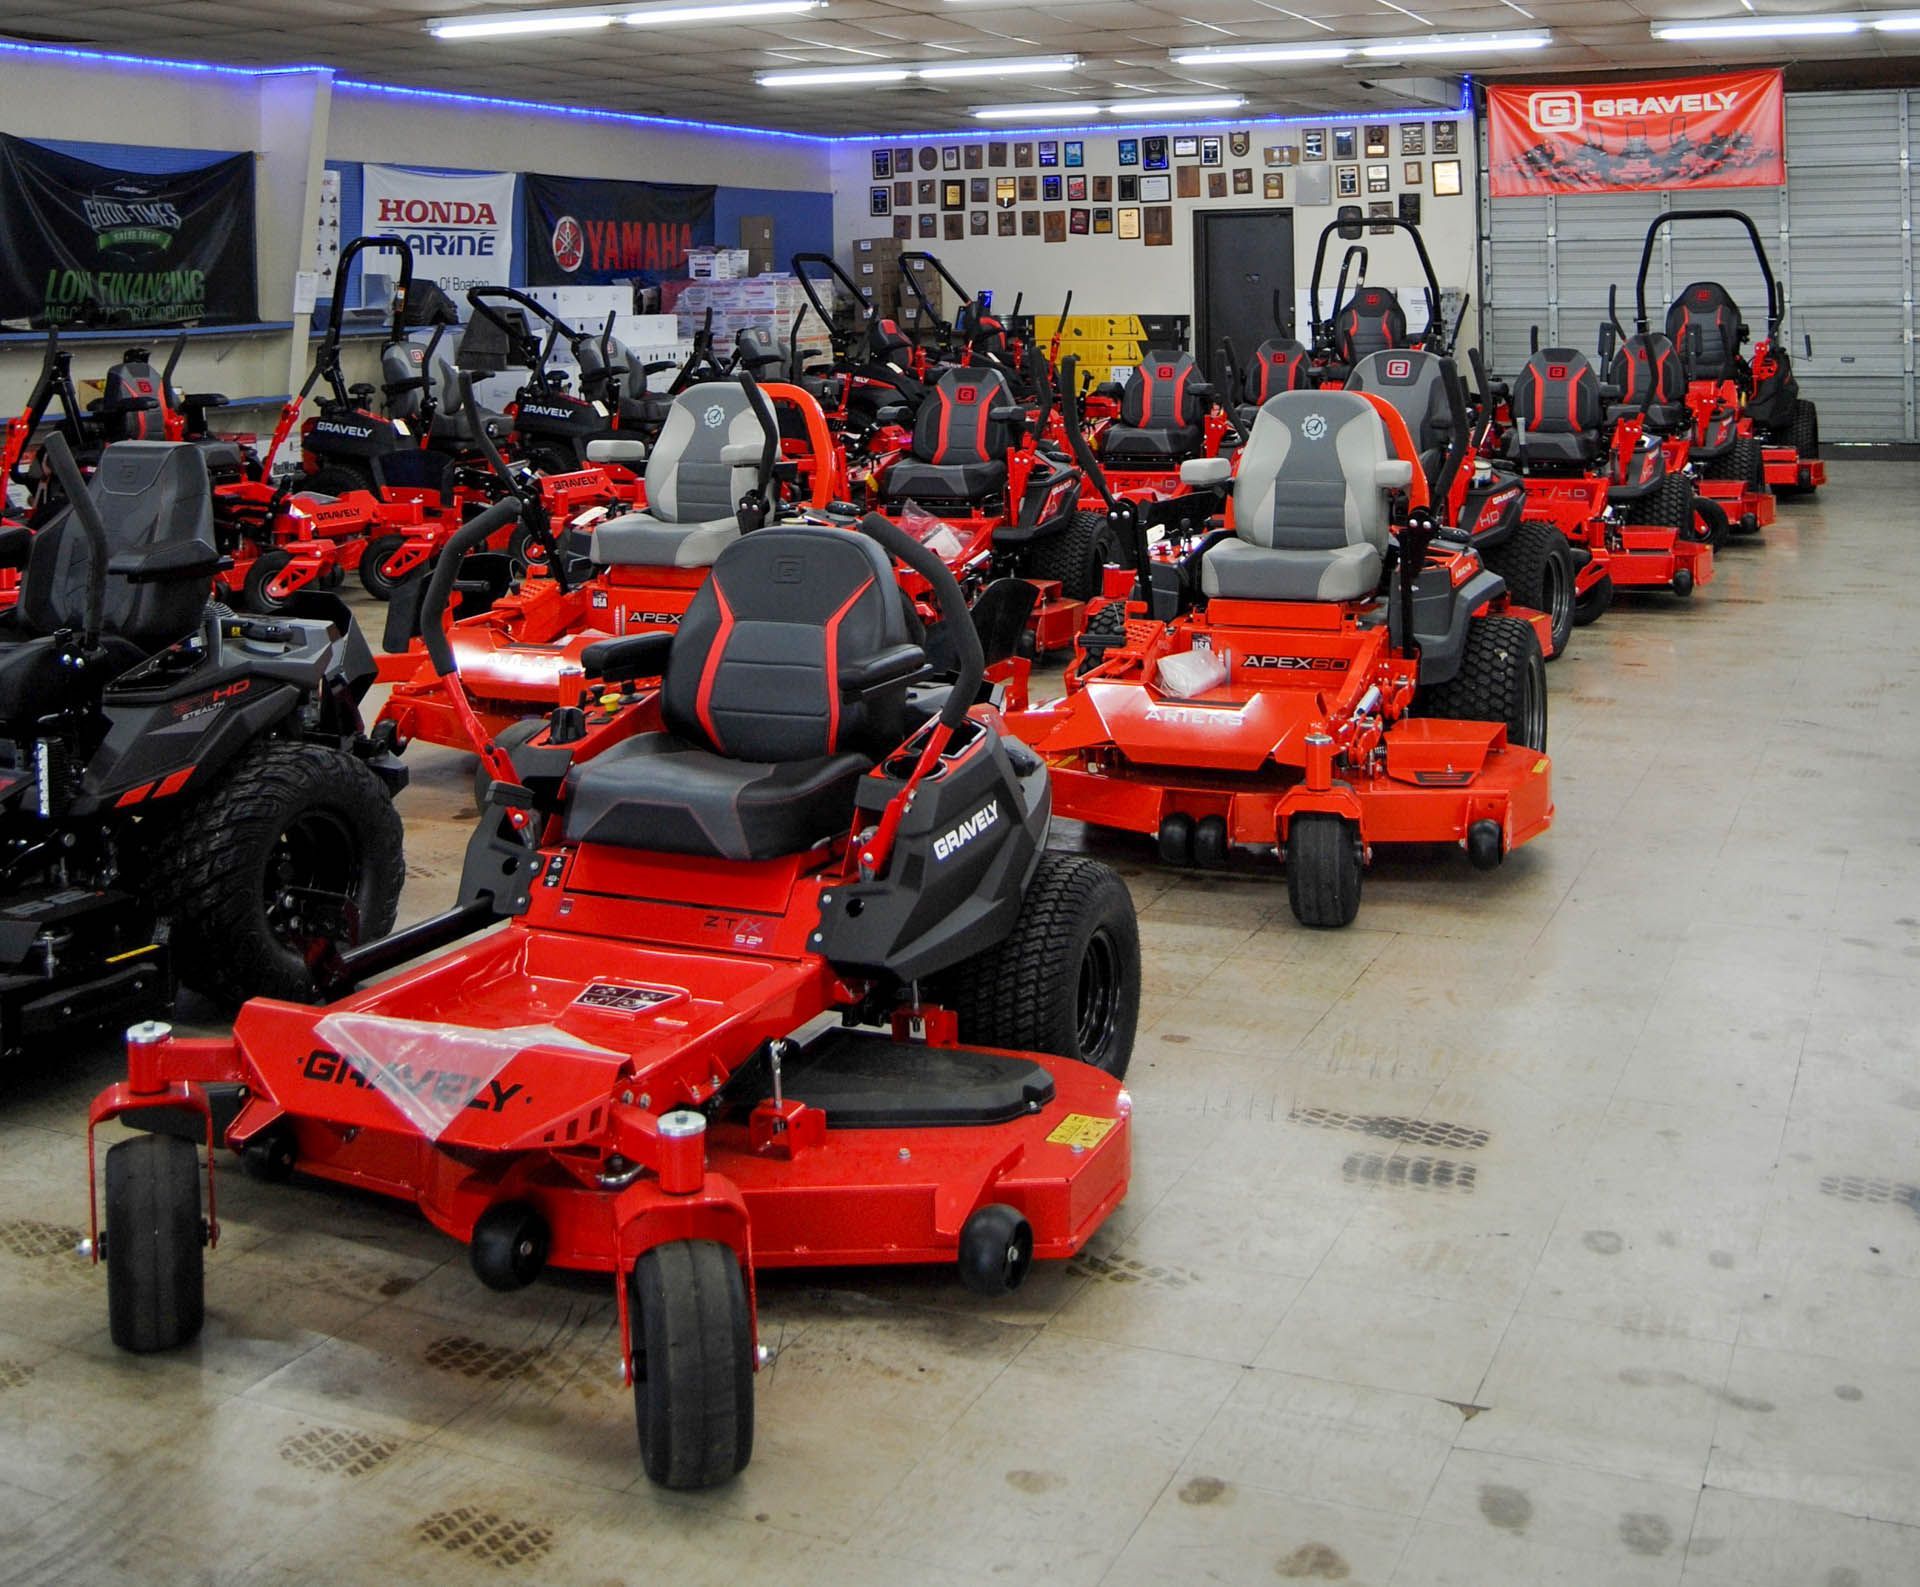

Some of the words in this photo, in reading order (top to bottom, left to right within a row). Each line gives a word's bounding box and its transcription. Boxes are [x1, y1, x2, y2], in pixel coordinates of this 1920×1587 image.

[1593, 92, 1738, 117] GRAVELY
[377, 199, 497, 225] HONDA
[585, 220, 693, 270] YAMAHA
[44, 269, 96, 303] LOW
[98, 269, 205, 305] FINANCING
[317, 421, 372, 437] GRAVELY
[553, 475, 598, 489] GRAVELY
[316, 508, 360, 521] GRAVELY
[1479, 510, 1500, 528] HD
[182, 700, 226, 721] STEALTH
[1144, 709, 1246, 726] ARIENS
[933, 799, 999, 861] GRAVELY
[303, 1049, 524, 1113] GRAVELY
